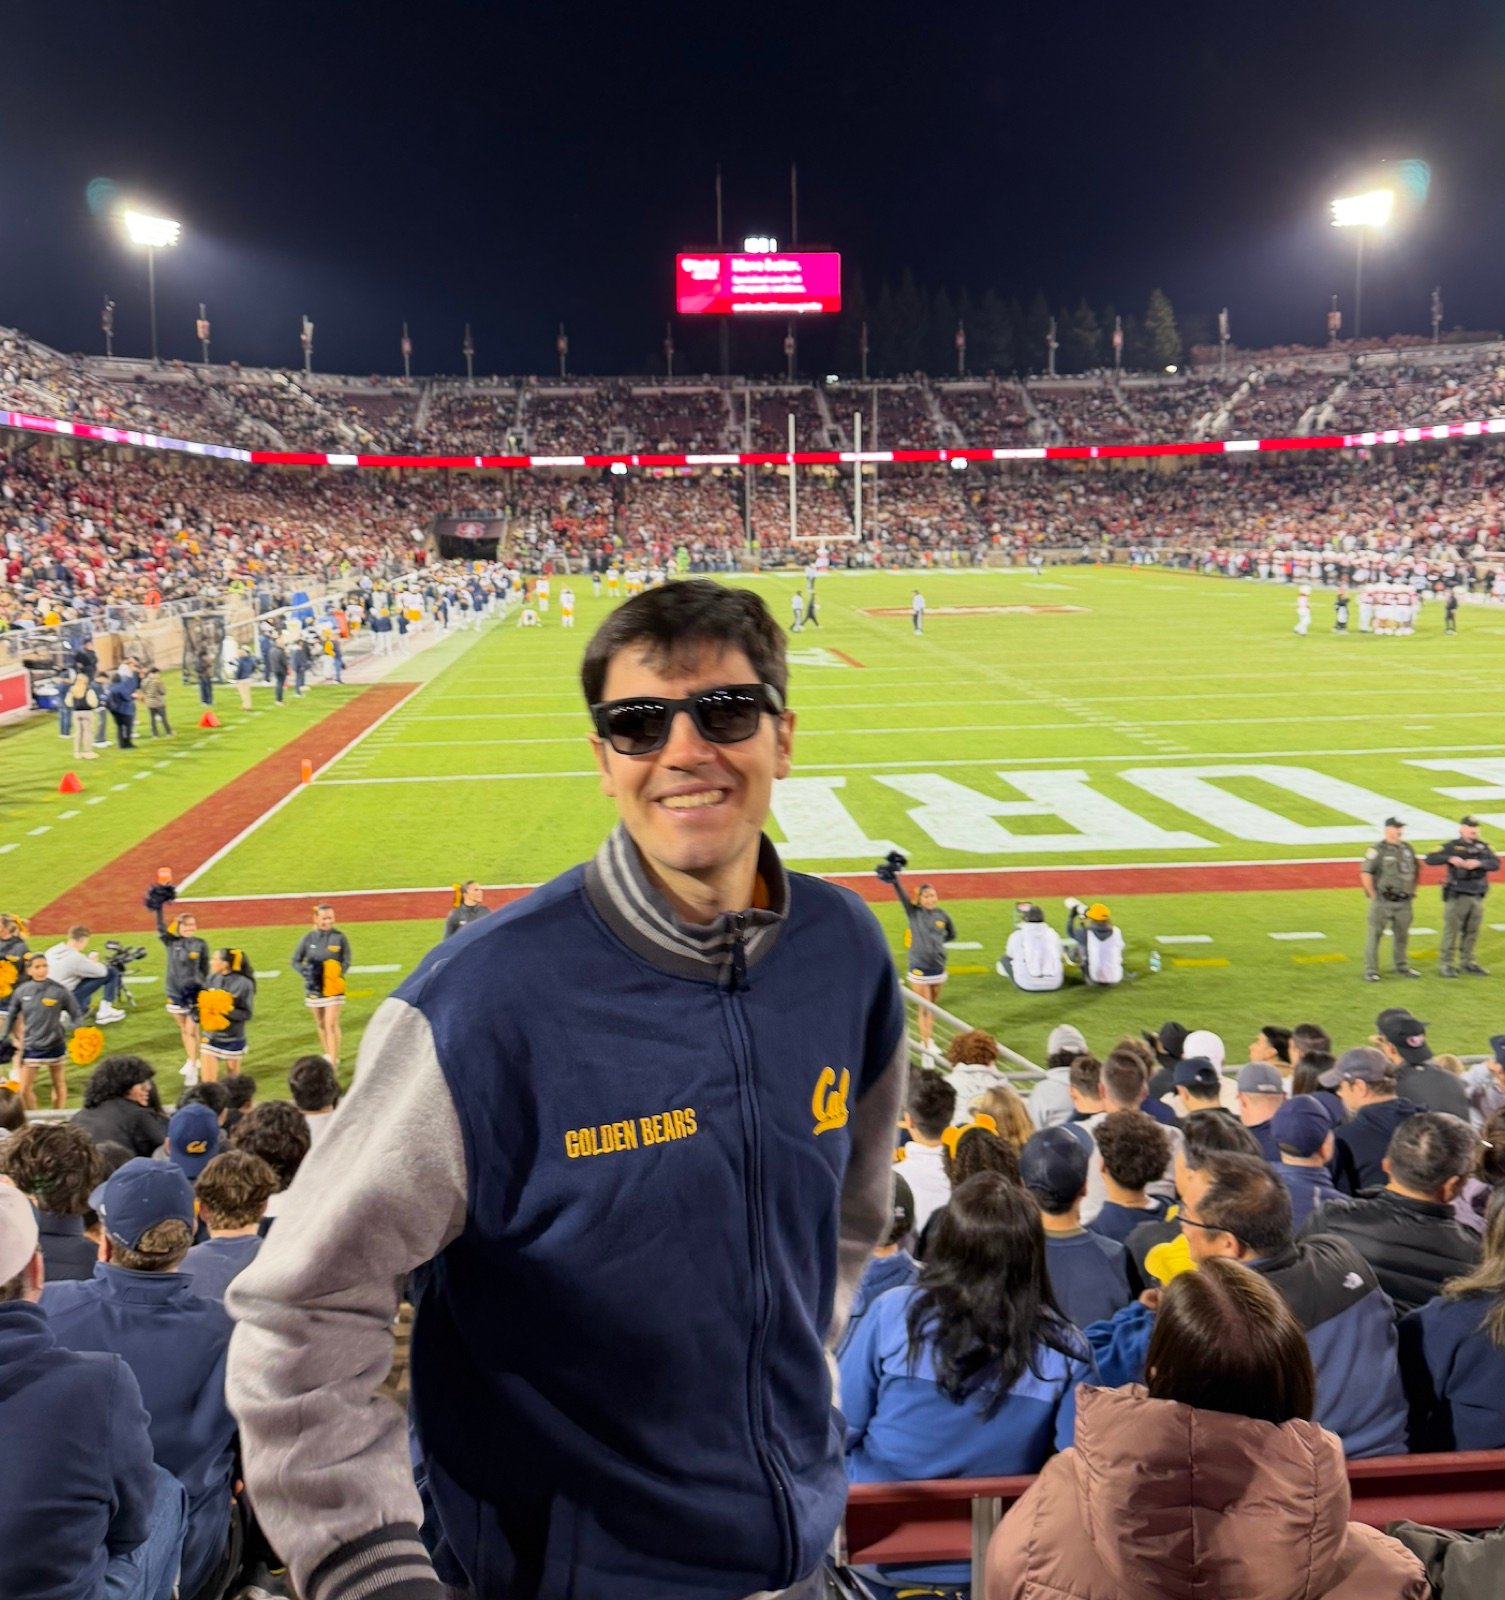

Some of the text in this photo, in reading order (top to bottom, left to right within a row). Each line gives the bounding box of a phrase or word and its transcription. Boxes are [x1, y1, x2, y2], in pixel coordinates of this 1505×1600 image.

[810, 1066, 851, 1136] Cal
[565, 1107, 698, 1159] GOLDEN BEARS
